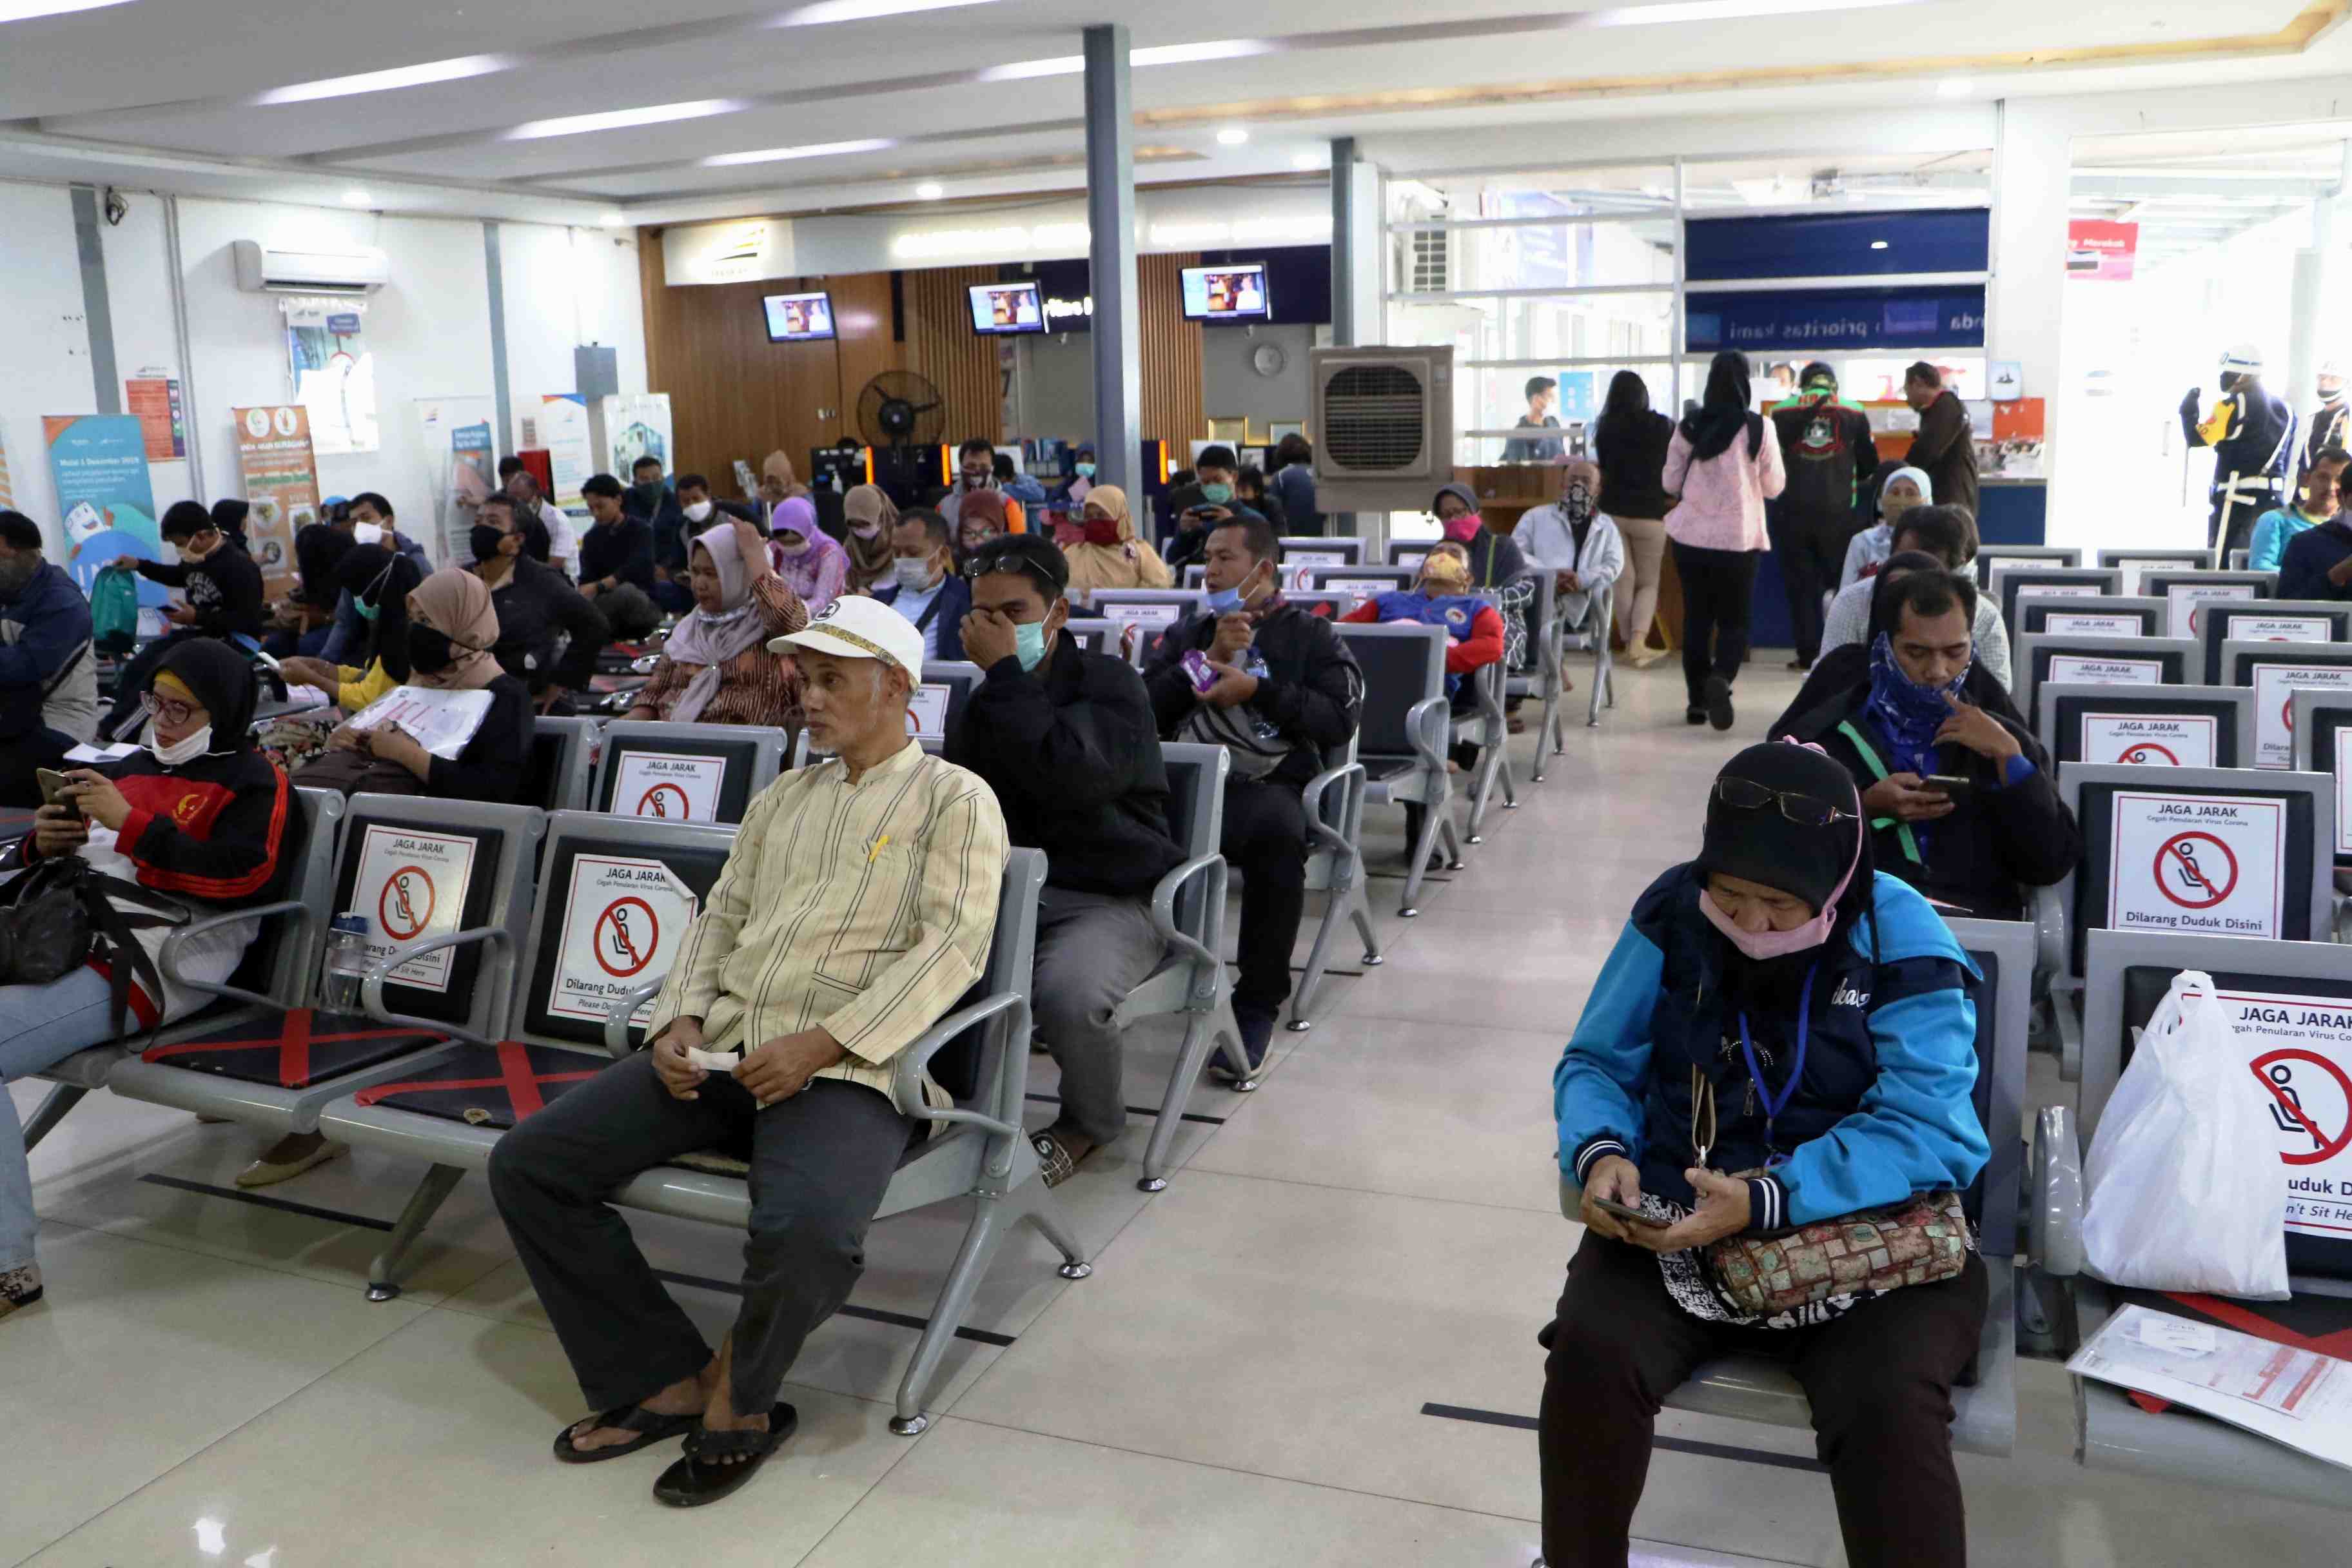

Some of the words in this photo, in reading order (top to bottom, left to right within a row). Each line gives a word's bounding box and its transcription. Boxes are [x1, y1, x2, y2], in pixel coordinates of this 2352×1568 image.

[2285, 671, 2309, 679] JAGA
[2312, 672, 2342, 680] JARAK
[2117, 722, 2144, 730] JAGA
[2148, 723, 2180, 732] JARAK
[646, 761, 667, 770] JAGA
[669, 763, 696, 772] JARAK
[2158, 804, 2192, 815] JAGA
[2196, 806, 2239, 818] JARAK
[393, 838, 415, 850] JAGA
[418, 841, 445, 854] JARAK
[606, 868, 632, 879] JAGA
[2126, 912, 2177, 927] Dilarang
[2181, 915, 2220, 928] Duduk
[2225, 918, 2262, 930] Disini
[566, 978, 605, 995] Dilarang
[578, 999, 600, 1008] Please
[2239, 1006, 2290, 1024] JAGA
[2256, 1025, 2306, 1037] Penularan
[2309, 1030, 2335, 1041] Virus
[1037, 1140, 1052, 1154] S
[2288, 1177, 2333, 1194] uduk
[2286, 1203, 2306, 1215] n't
[2309, 1206, 2331, 1218] Sit
[2335, 1208, 2352, 1220] He
